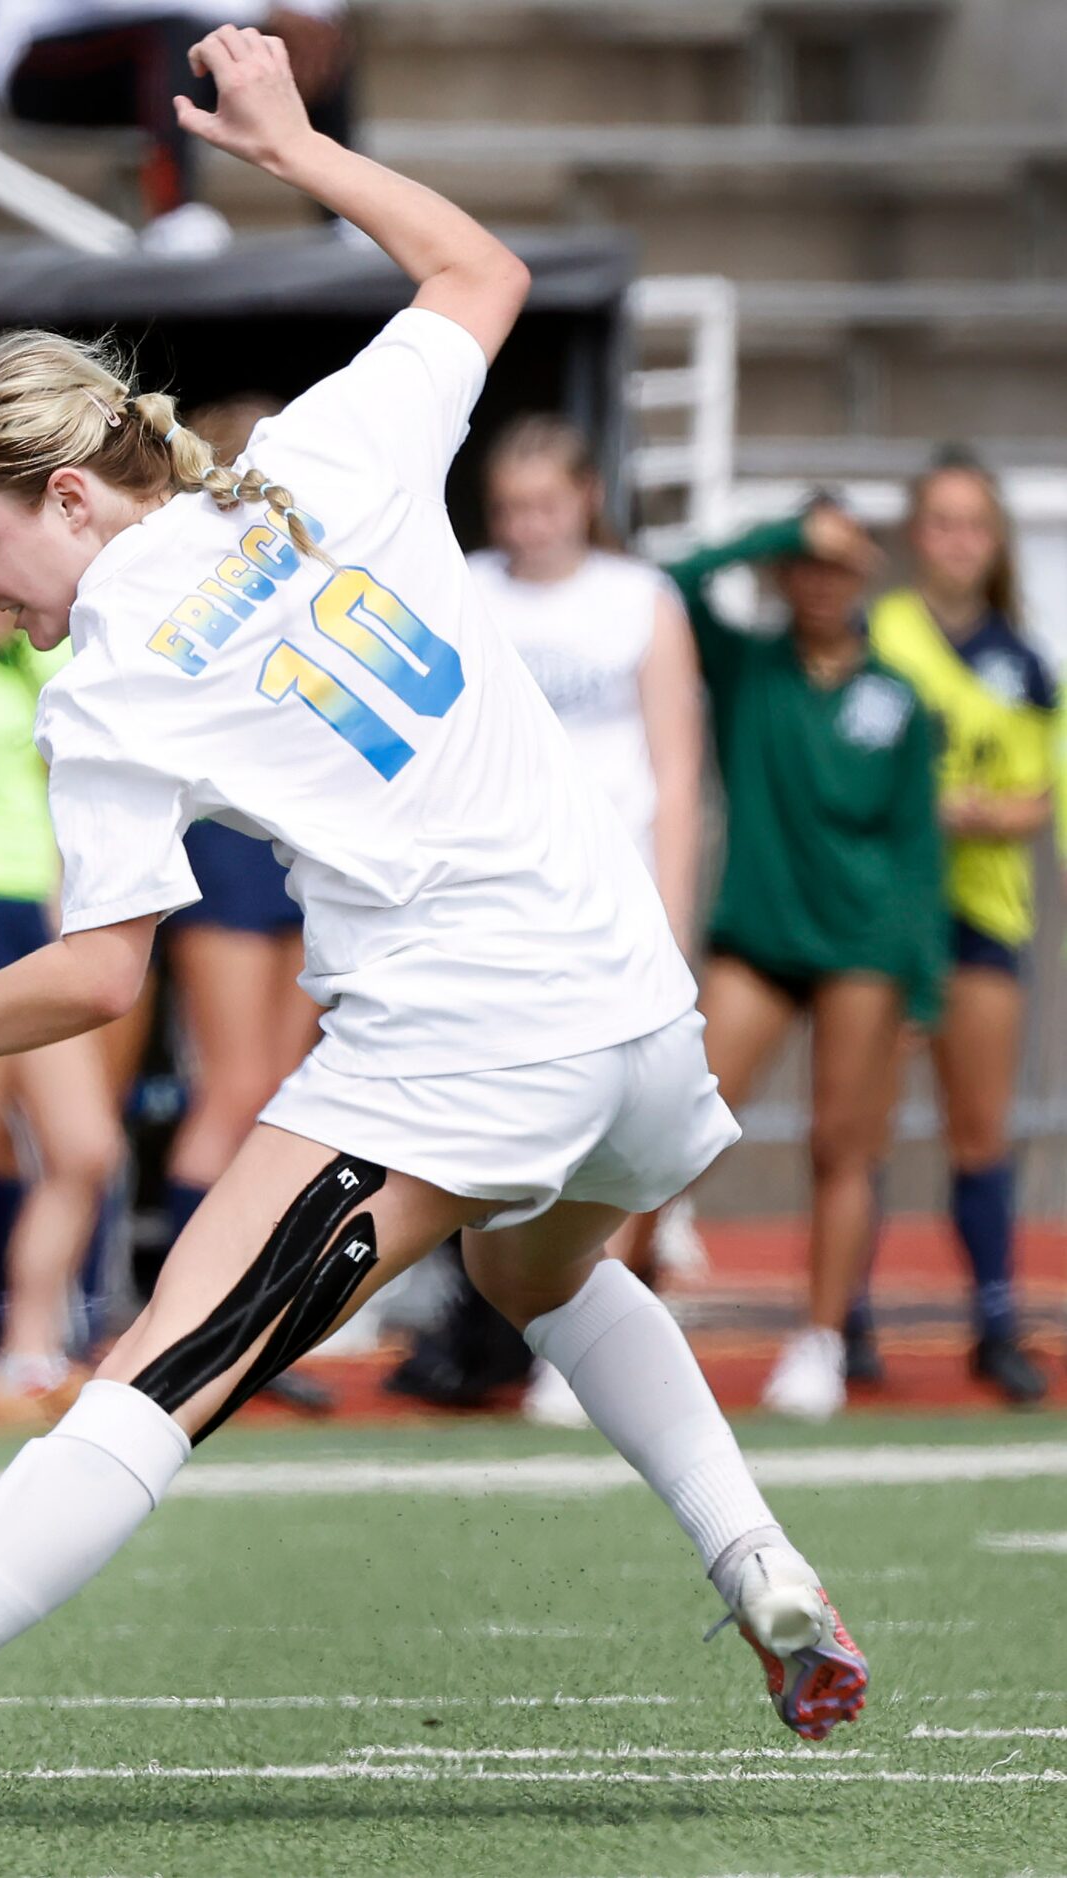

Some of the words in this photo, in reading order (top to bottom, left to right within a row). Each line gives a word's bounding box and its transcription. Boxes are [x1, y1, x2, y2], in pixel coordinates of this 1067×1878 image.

[256, 566, 466, 783] 10
[336, 1167, 360, 1190] KT
[343, 1239, 371, 1262] KT
